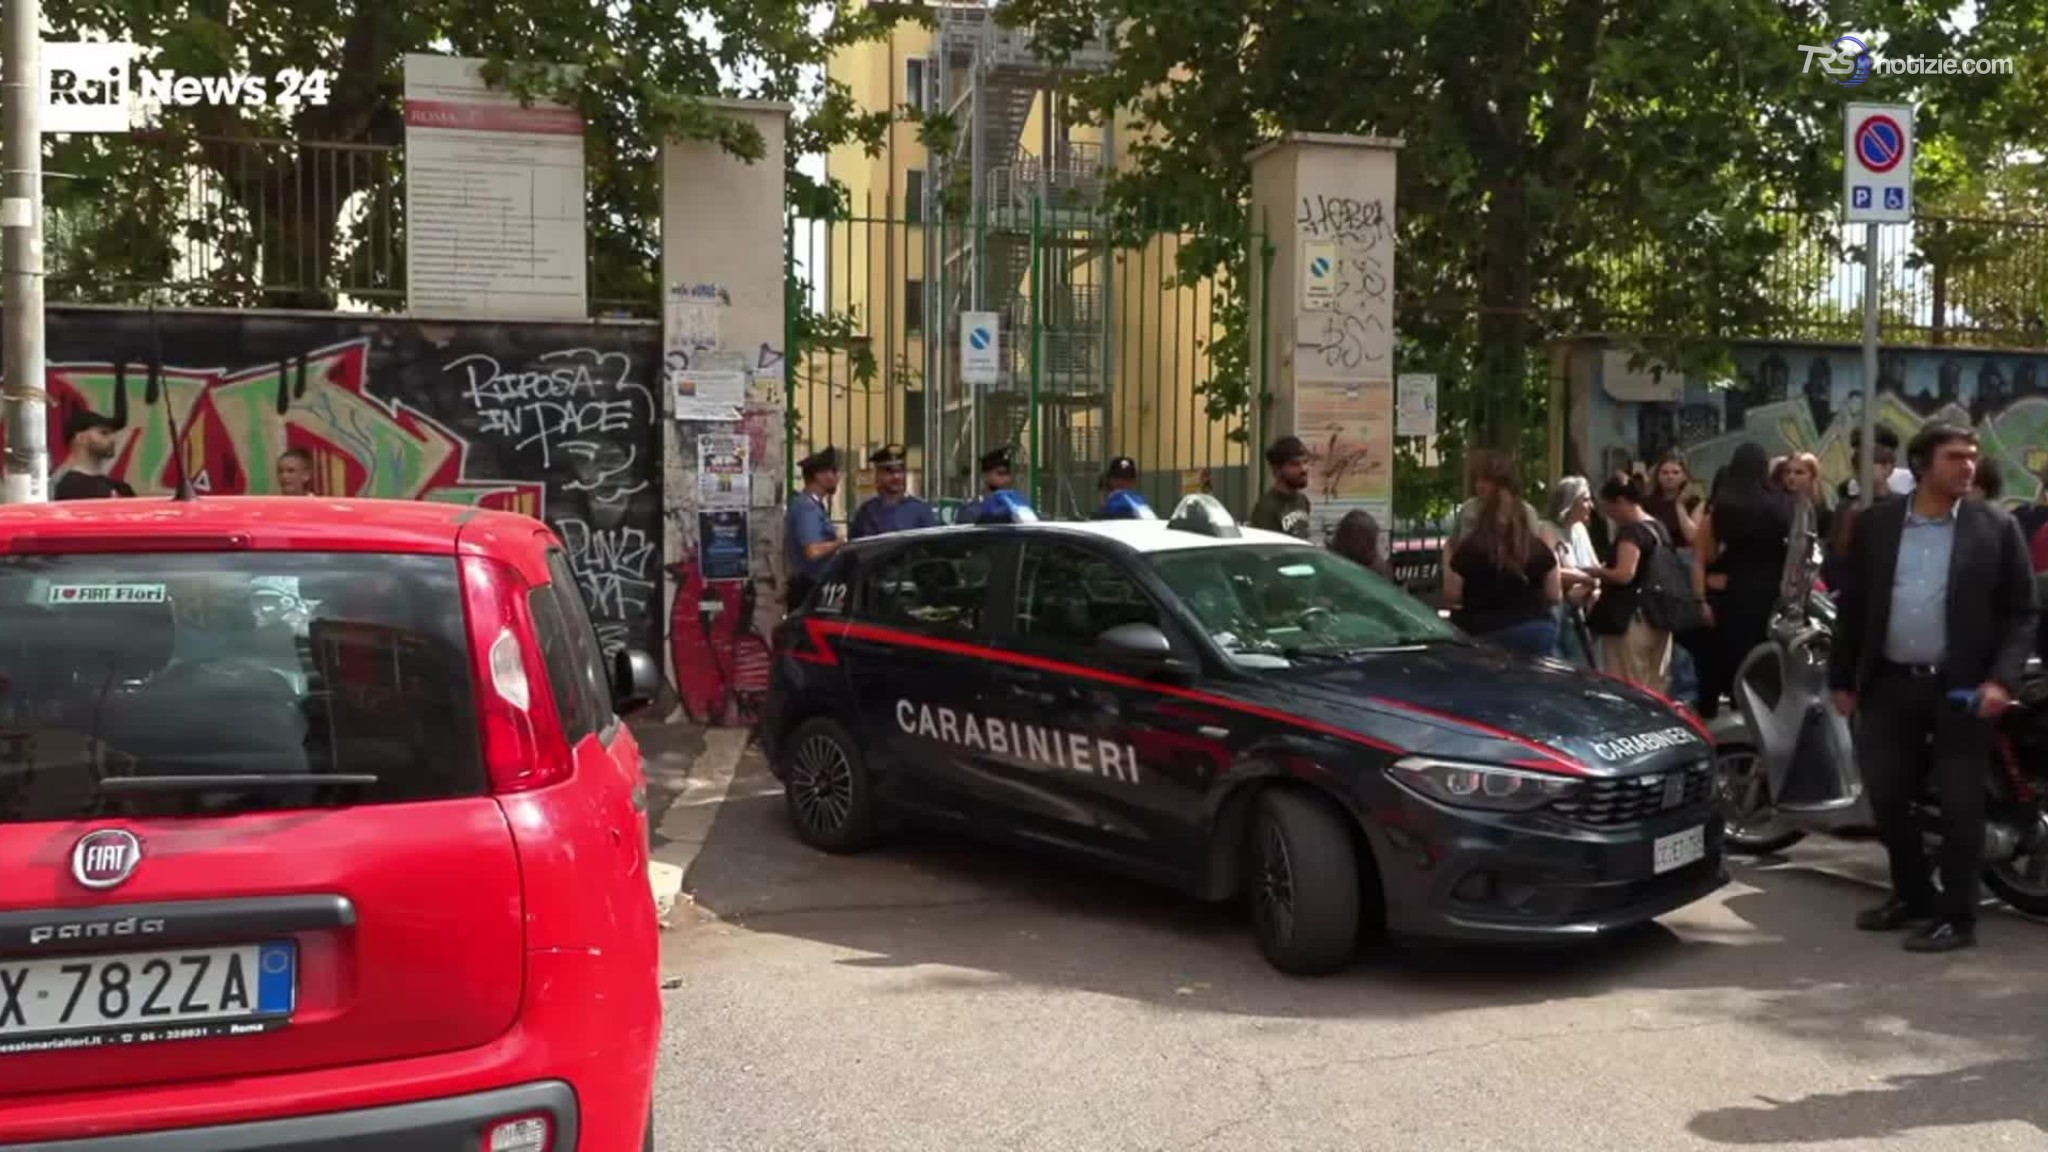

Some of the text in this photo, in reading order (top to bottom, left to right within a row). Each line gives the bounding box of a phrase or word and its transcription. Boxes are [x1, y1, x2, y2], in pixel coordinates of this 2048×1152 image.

[1855, 189, 1869, 206] P
[443, 354, 604, 408] RIPOSA
[478, 401, 633, 468] IN PACE
[79, 587, 111, 599] FIAT
[116, 585, 162, 599] Fiori
[822, 581, 847, 608] 112
[896, 699, 1140, 783] CARABINIERI
[86, 844, 127, 871] FIAT
[30, 917, 165, 943] panda
[230, 1022, 264, 1034] Roma
